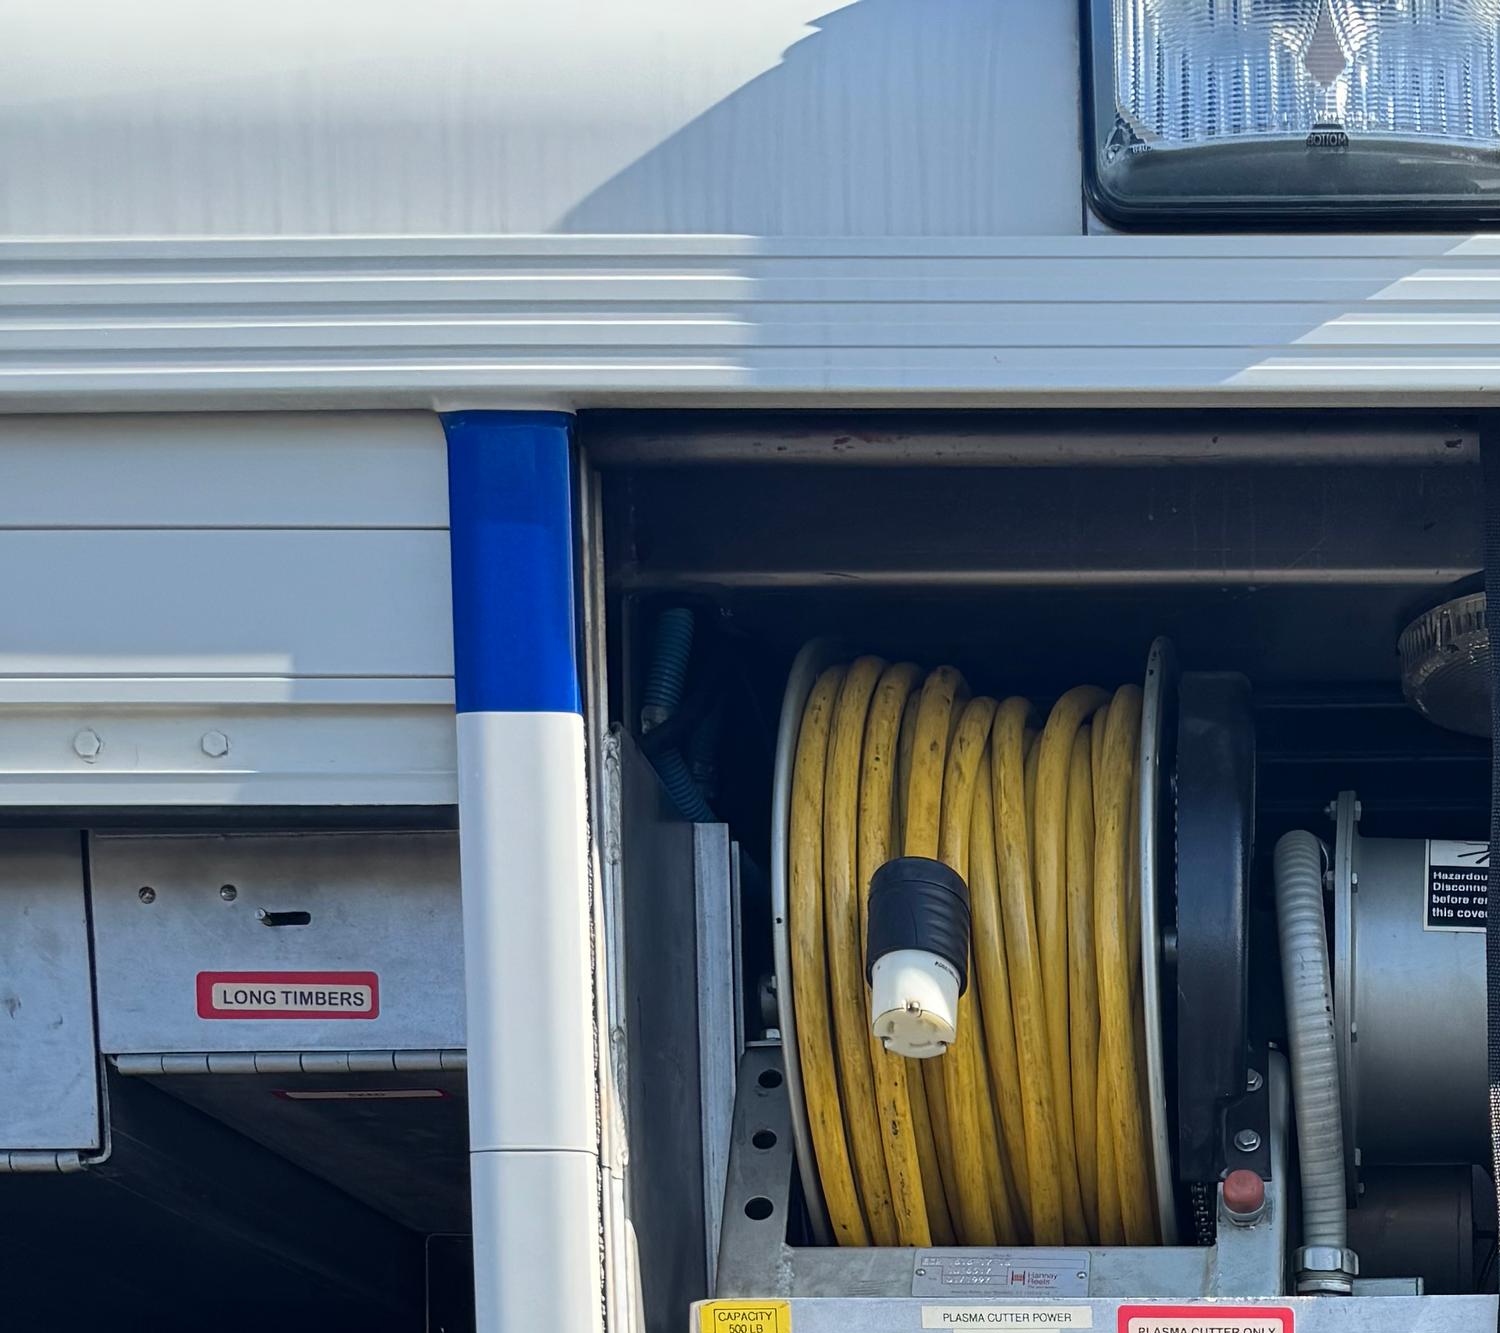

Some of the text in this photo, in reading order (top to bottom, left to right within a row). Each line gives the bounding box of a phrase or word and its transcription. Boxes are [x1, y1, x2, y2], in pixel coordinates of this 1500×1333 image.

[1433, 871, 1488, 881] Hazardou
[1433, 882, 1488, 893] Disconne
[1432, 894, 1470, 905] before
[1432, 907, 1454, 918] this
[222, 990, 365, 1007] LONG TIMBERS
[717, 1311, 773, 1323] CAPACITY
[942, 1312, 1073, 1323] PLASMA CUTTER POWER
